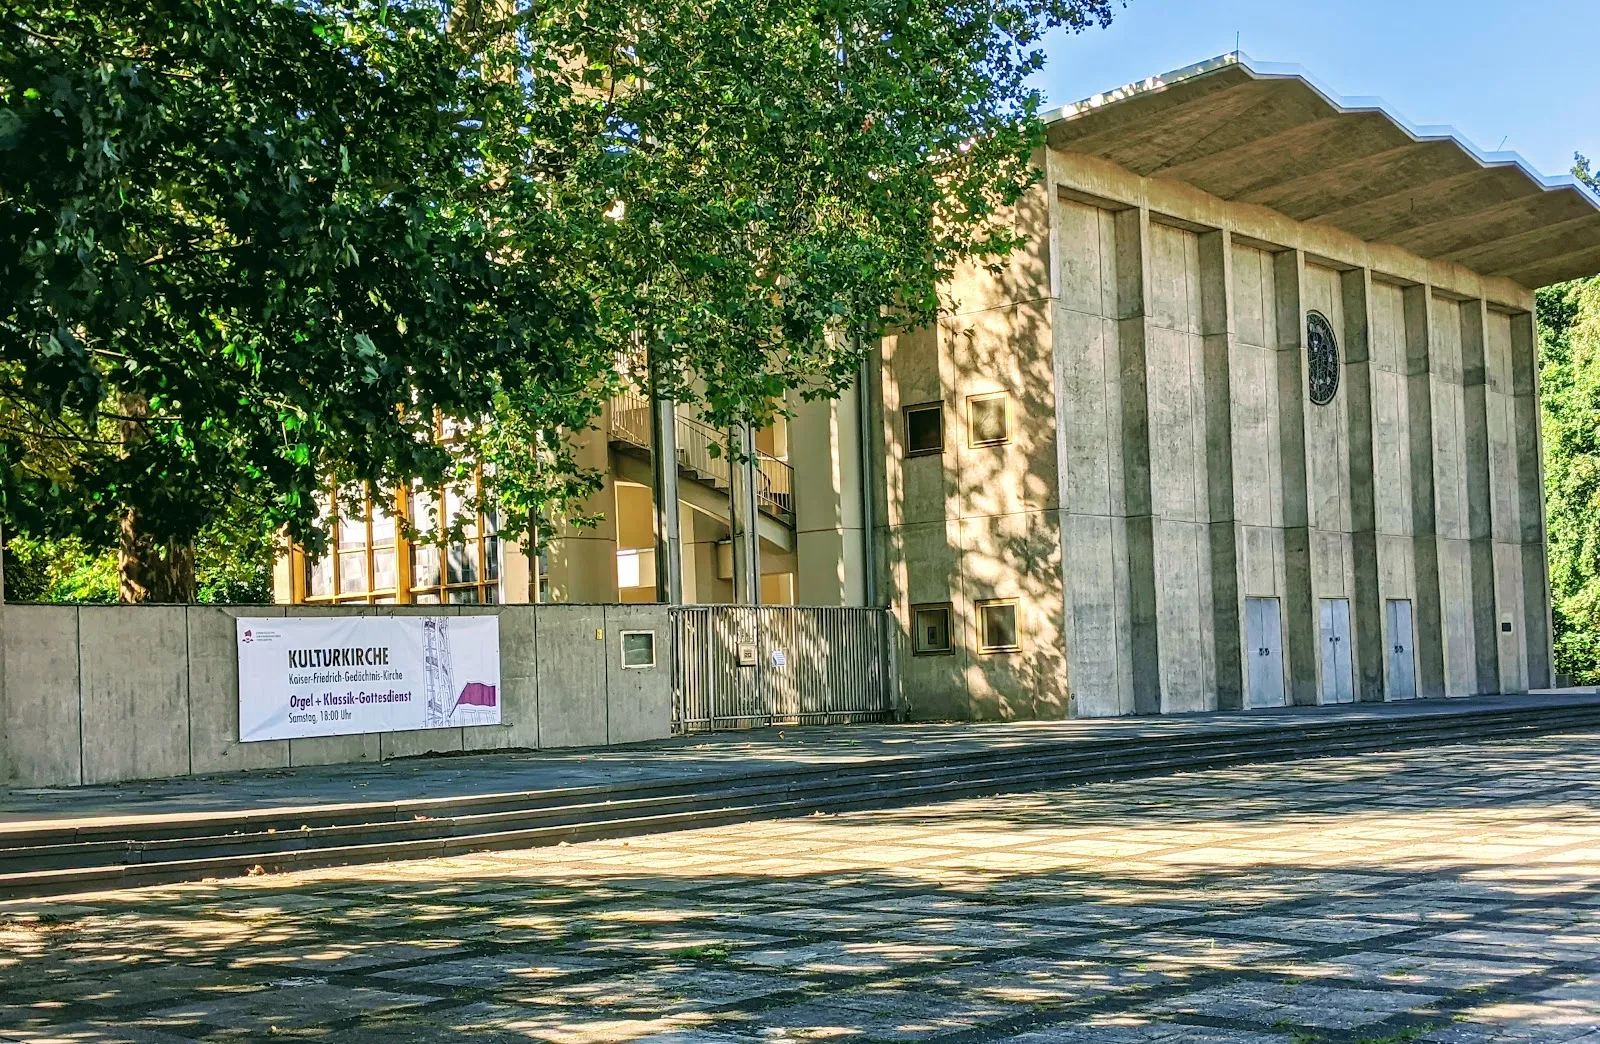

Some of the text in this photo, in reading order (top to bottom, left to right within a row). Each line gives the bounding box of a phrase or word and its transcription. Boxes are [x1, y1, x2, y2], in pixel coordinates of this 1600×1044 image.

[288, 647, 389, 668] KULTURKIRCHE
[289, 669, 403, 685] Kaiser-Friedrich-Gedächtnis-Kirche
[290, 693, 314, 710] Orgel
[323, 690, 412, 706] Klassik-Gottesdienst
[288, 709, 352, 725] Samstag, 18:00 Uhr
